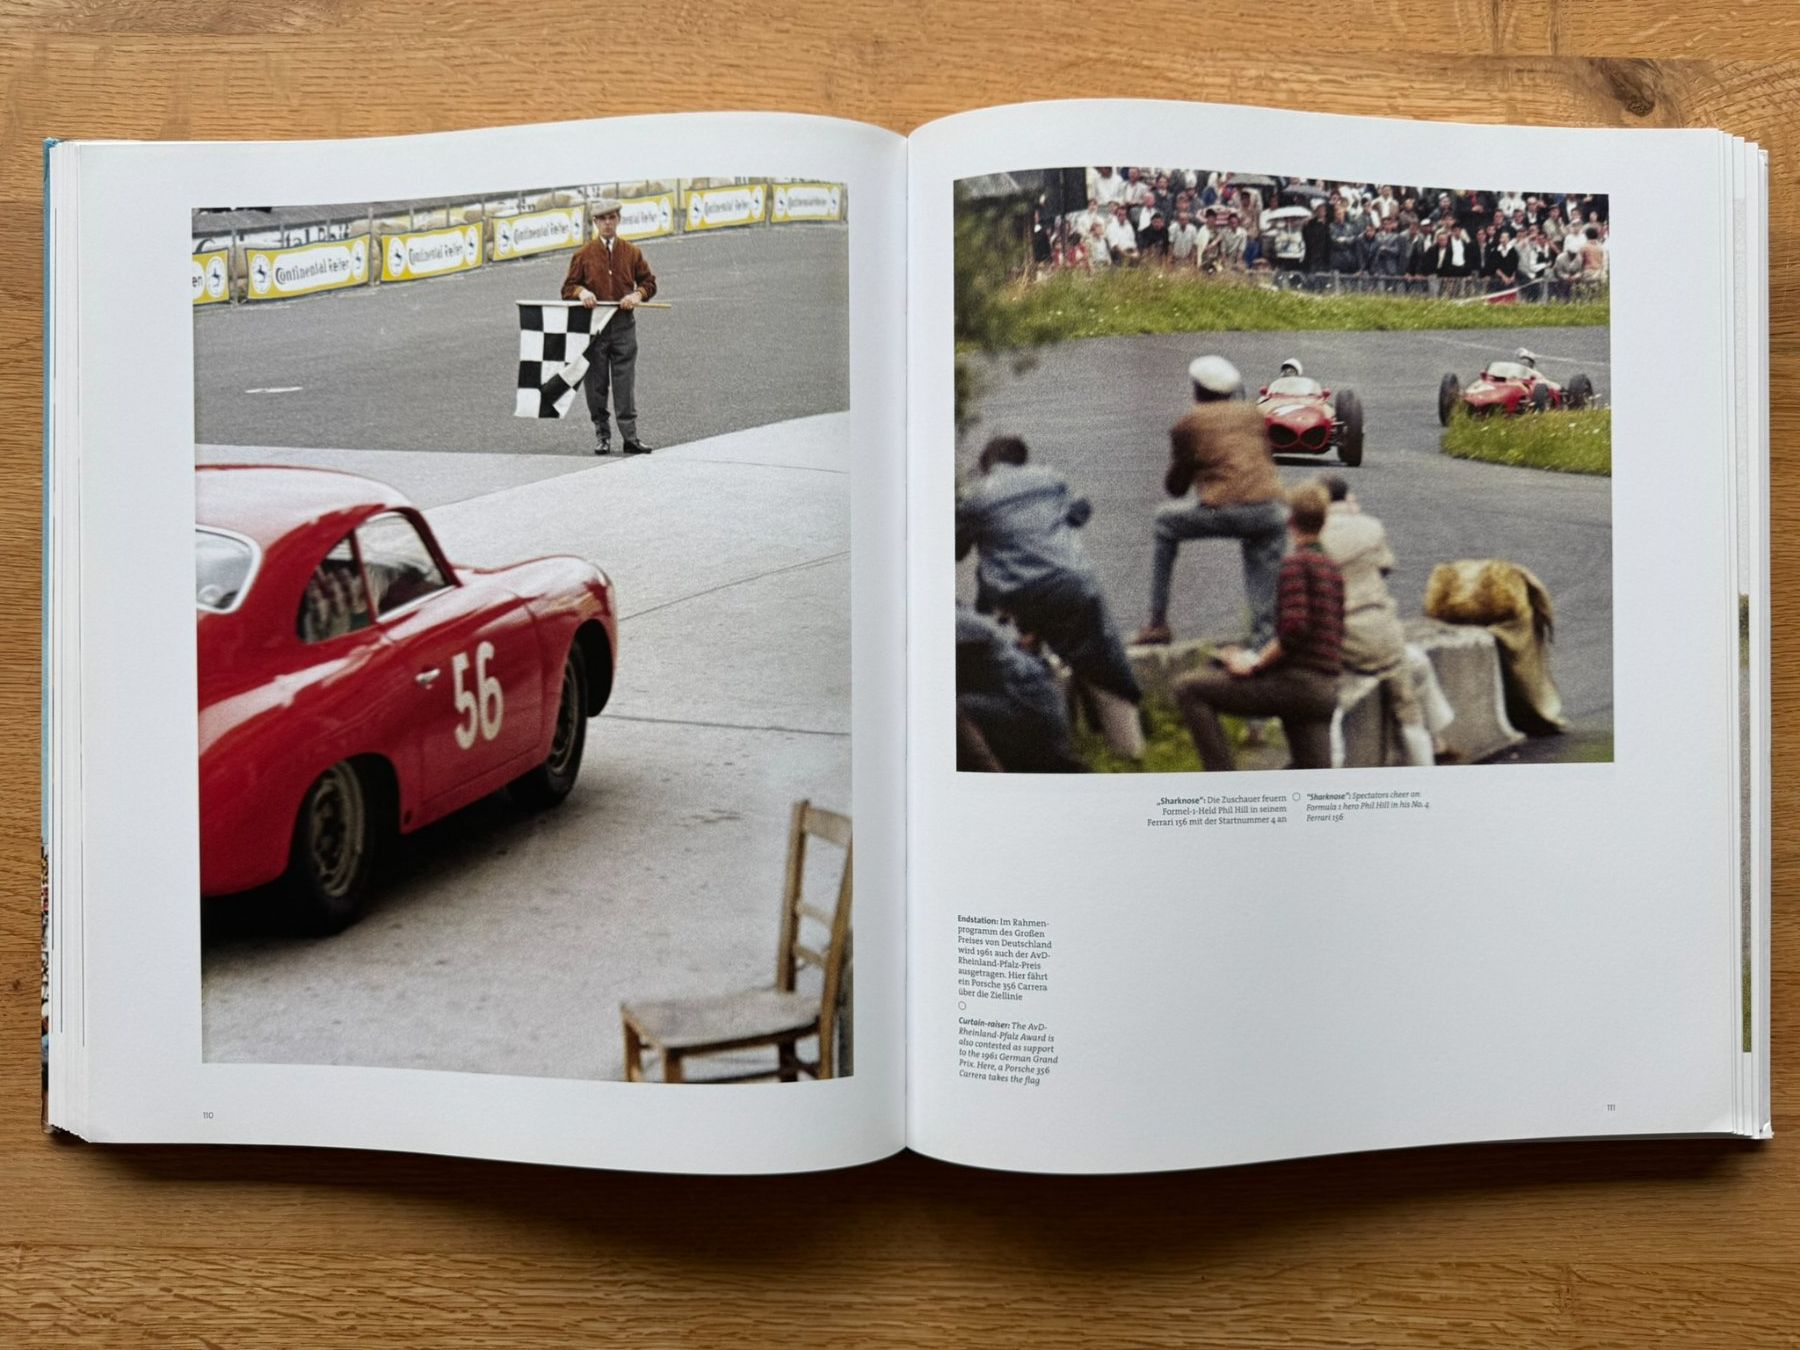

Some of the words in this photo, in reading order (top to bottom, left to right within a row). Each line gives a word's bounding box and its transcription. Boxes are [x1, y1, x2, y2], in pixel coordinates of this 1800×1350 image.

[275, 258, 327, 285] Continental
[452, 641, 504, 750] 56
[1353, 792, 1388, 800] Spectators
[1162, 806, 1216, 815] Formel-1-Held
[1176, 818, 1187, 827] 156
[1332, 813, 1343, 822] 156
[958, 915, 998, 925] Endstation:
[1013, 919, 1049, 927] Rahmen-
[958, 926, 998, 935] programm
[958, 936, 983, 944] Preises
[1002, 940, 1052, 948] Deutschland
[977, 948, 993, 957] 1961
[958, 957, 1040, 969] Rheinland-Pfalz-Preis
[958, 968, 1007, 979] ausgetragen.
[1008, 971, 1025, 979] Hier
[1027, 972, 1048, 980] fährt
[972, 979, 1000, 988] Porsche
[1003, 982, 1016, 990] 356
[959, 988, 975, 996] über
[990, 991, 1022, 1000] Ziellinie
[959, 1017, 1010, 1029] Curtain-raiser:
[959, 1027, 1018, 1041] Rheinland-Pfalz
[1021, 1034, 1046, 1042] Award
[959, 1038, 973, 1046] also
[975, 1041, 1011, 1050] contested
[1023, 1045, 1054, 1054] support
[968, 1049, 980, 1058] the
[1000, 1053, 1031, 1062] German
[1033, 1055, 1058, 1064] Grand
[959, 1059, 975, 1068] Prix.
[977, 1061, 996, 1071] Here,
[1005, 1064, 1034, 1073] Porsche
[1036, 1066, 1050, 1075] 356
[959, 1070, 986, 1080] Carrera
[988, 1074, 1008, 1082] takes
[1010, 1075, 1023, 1083] the
[1024, 1076, 1040, 1086] flag
[202, 1111, 214, 1120] 110
